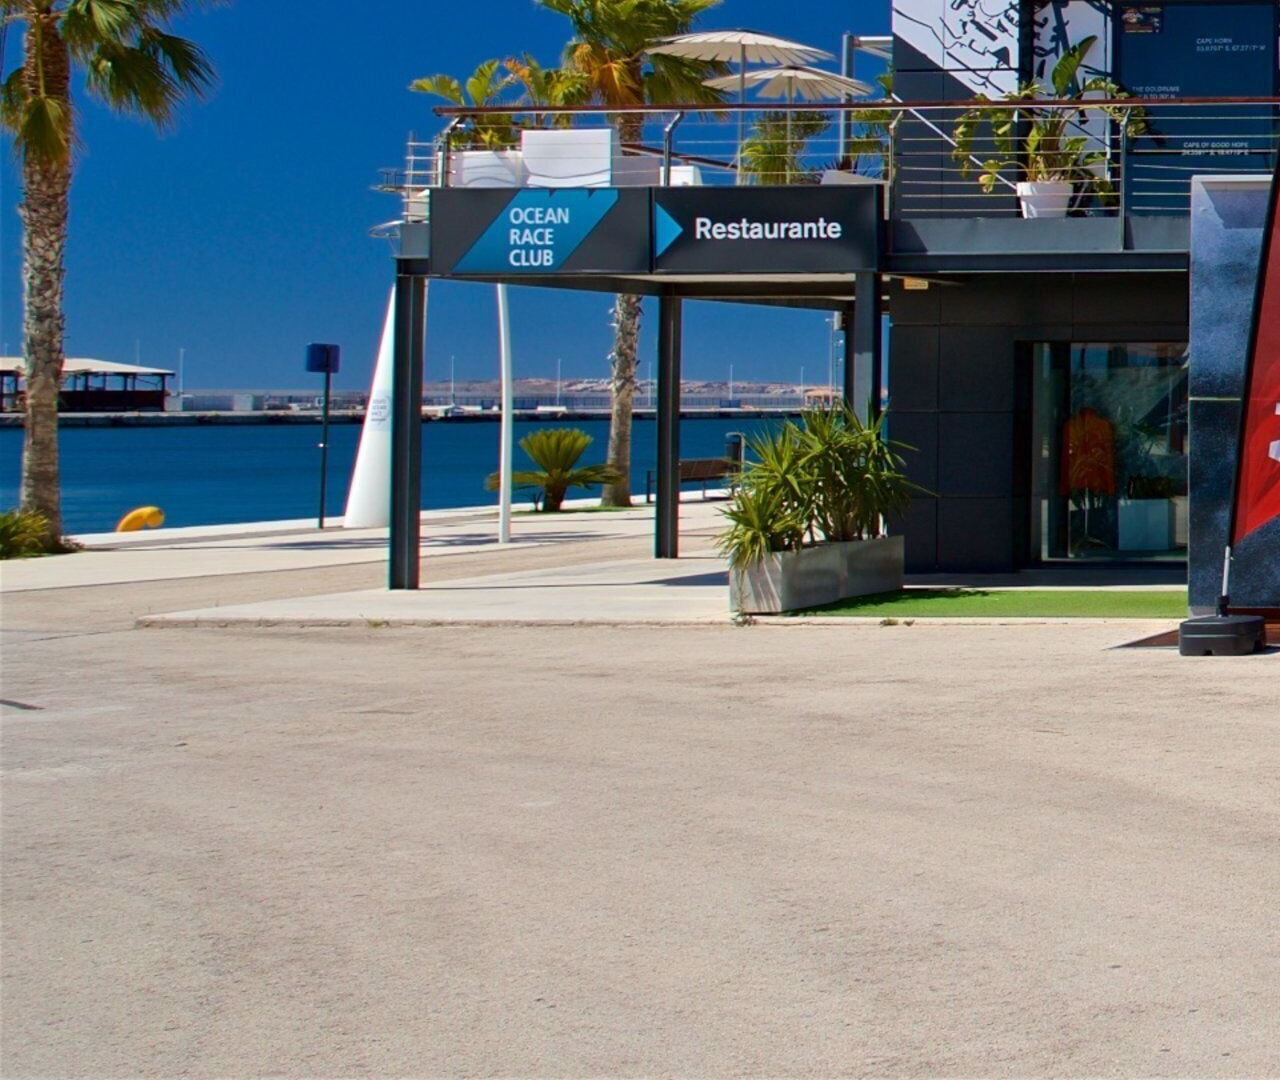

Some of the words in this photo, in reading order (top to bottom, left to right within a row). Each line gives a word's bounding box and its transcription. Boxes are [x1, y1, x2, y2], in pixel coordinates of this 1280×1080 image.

[509, 207, 569, 224] OCEAN
[509, 228, 554, 245] RACE
[695, 217, 842, 239] Restaurante
[509, 249, 553, 266] CLUB
